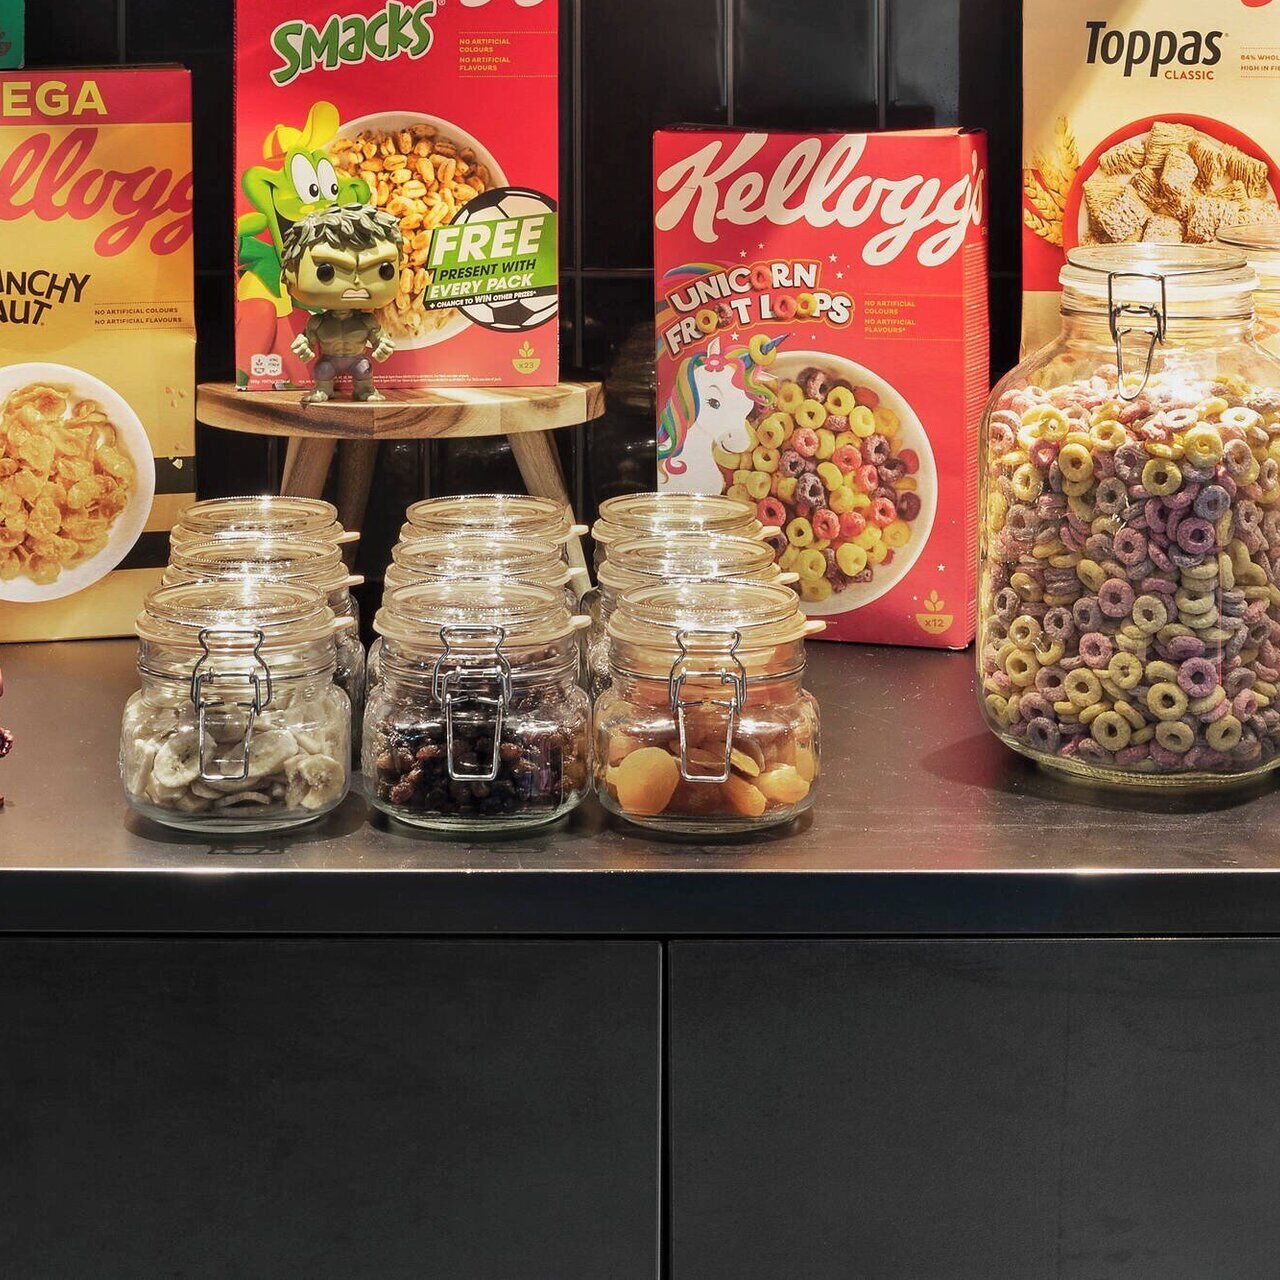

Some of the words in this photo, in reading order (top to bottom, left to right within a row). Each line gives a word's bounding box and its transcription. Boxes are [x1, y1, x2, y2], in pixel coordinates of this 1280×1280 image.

[1084, 20, 1224, 78] Toppas
[1164, 68, 1215, 81] CLASSIC
[432, 217, 545, 266] FREE
[439, 263, 498, 281] PRESENT
[502, 258, 537, 273] WITH
[430, 279, 483, 299] EVERY
[486, 272, 534, 292] PACK
[670, 263, 817, 313] UNICORN
[437, 300, 464, 308] CHANCE
[474, 293, 492, 303] WIN
[492, 293, 513, 301] OTHER
[876, 300, 917, 308] ARTIFICIAL
[665, 297, 752, 355] FROOT
[760, 292, 851, 324] LOOPS
[876, 318, 917, 326] ARTIFICIAL
